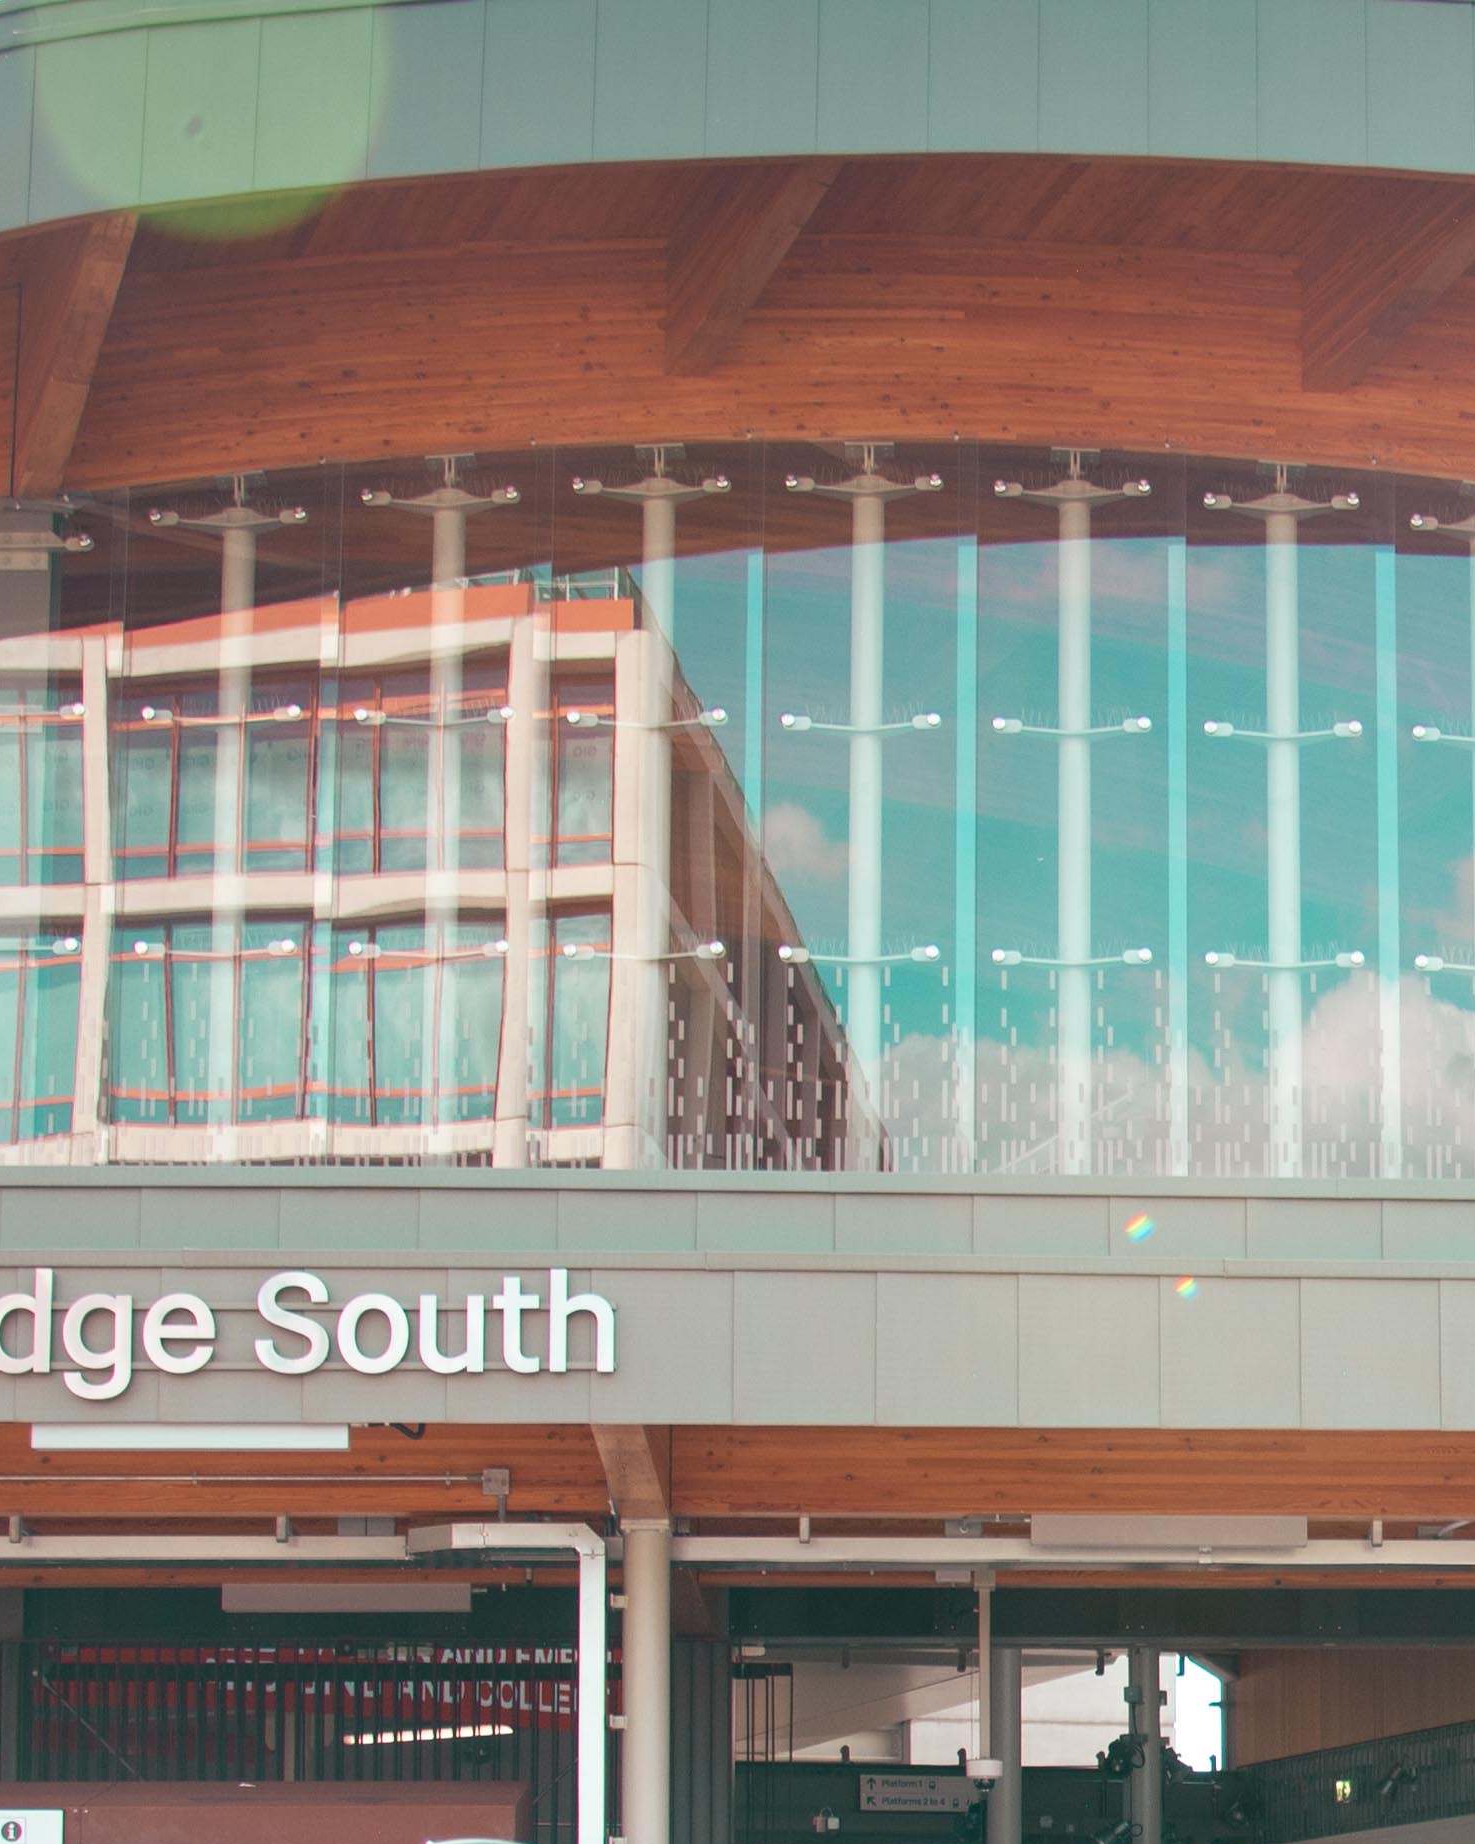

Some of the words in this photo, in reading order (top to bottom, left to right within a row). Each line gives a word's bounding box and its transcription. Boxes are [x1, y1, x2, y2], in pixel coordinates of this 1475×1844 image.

[254, 1269, 616, 1375] South
[881, 1779, 917, 1789] Platform
[881, 1796, 921, 1805] Platforms
